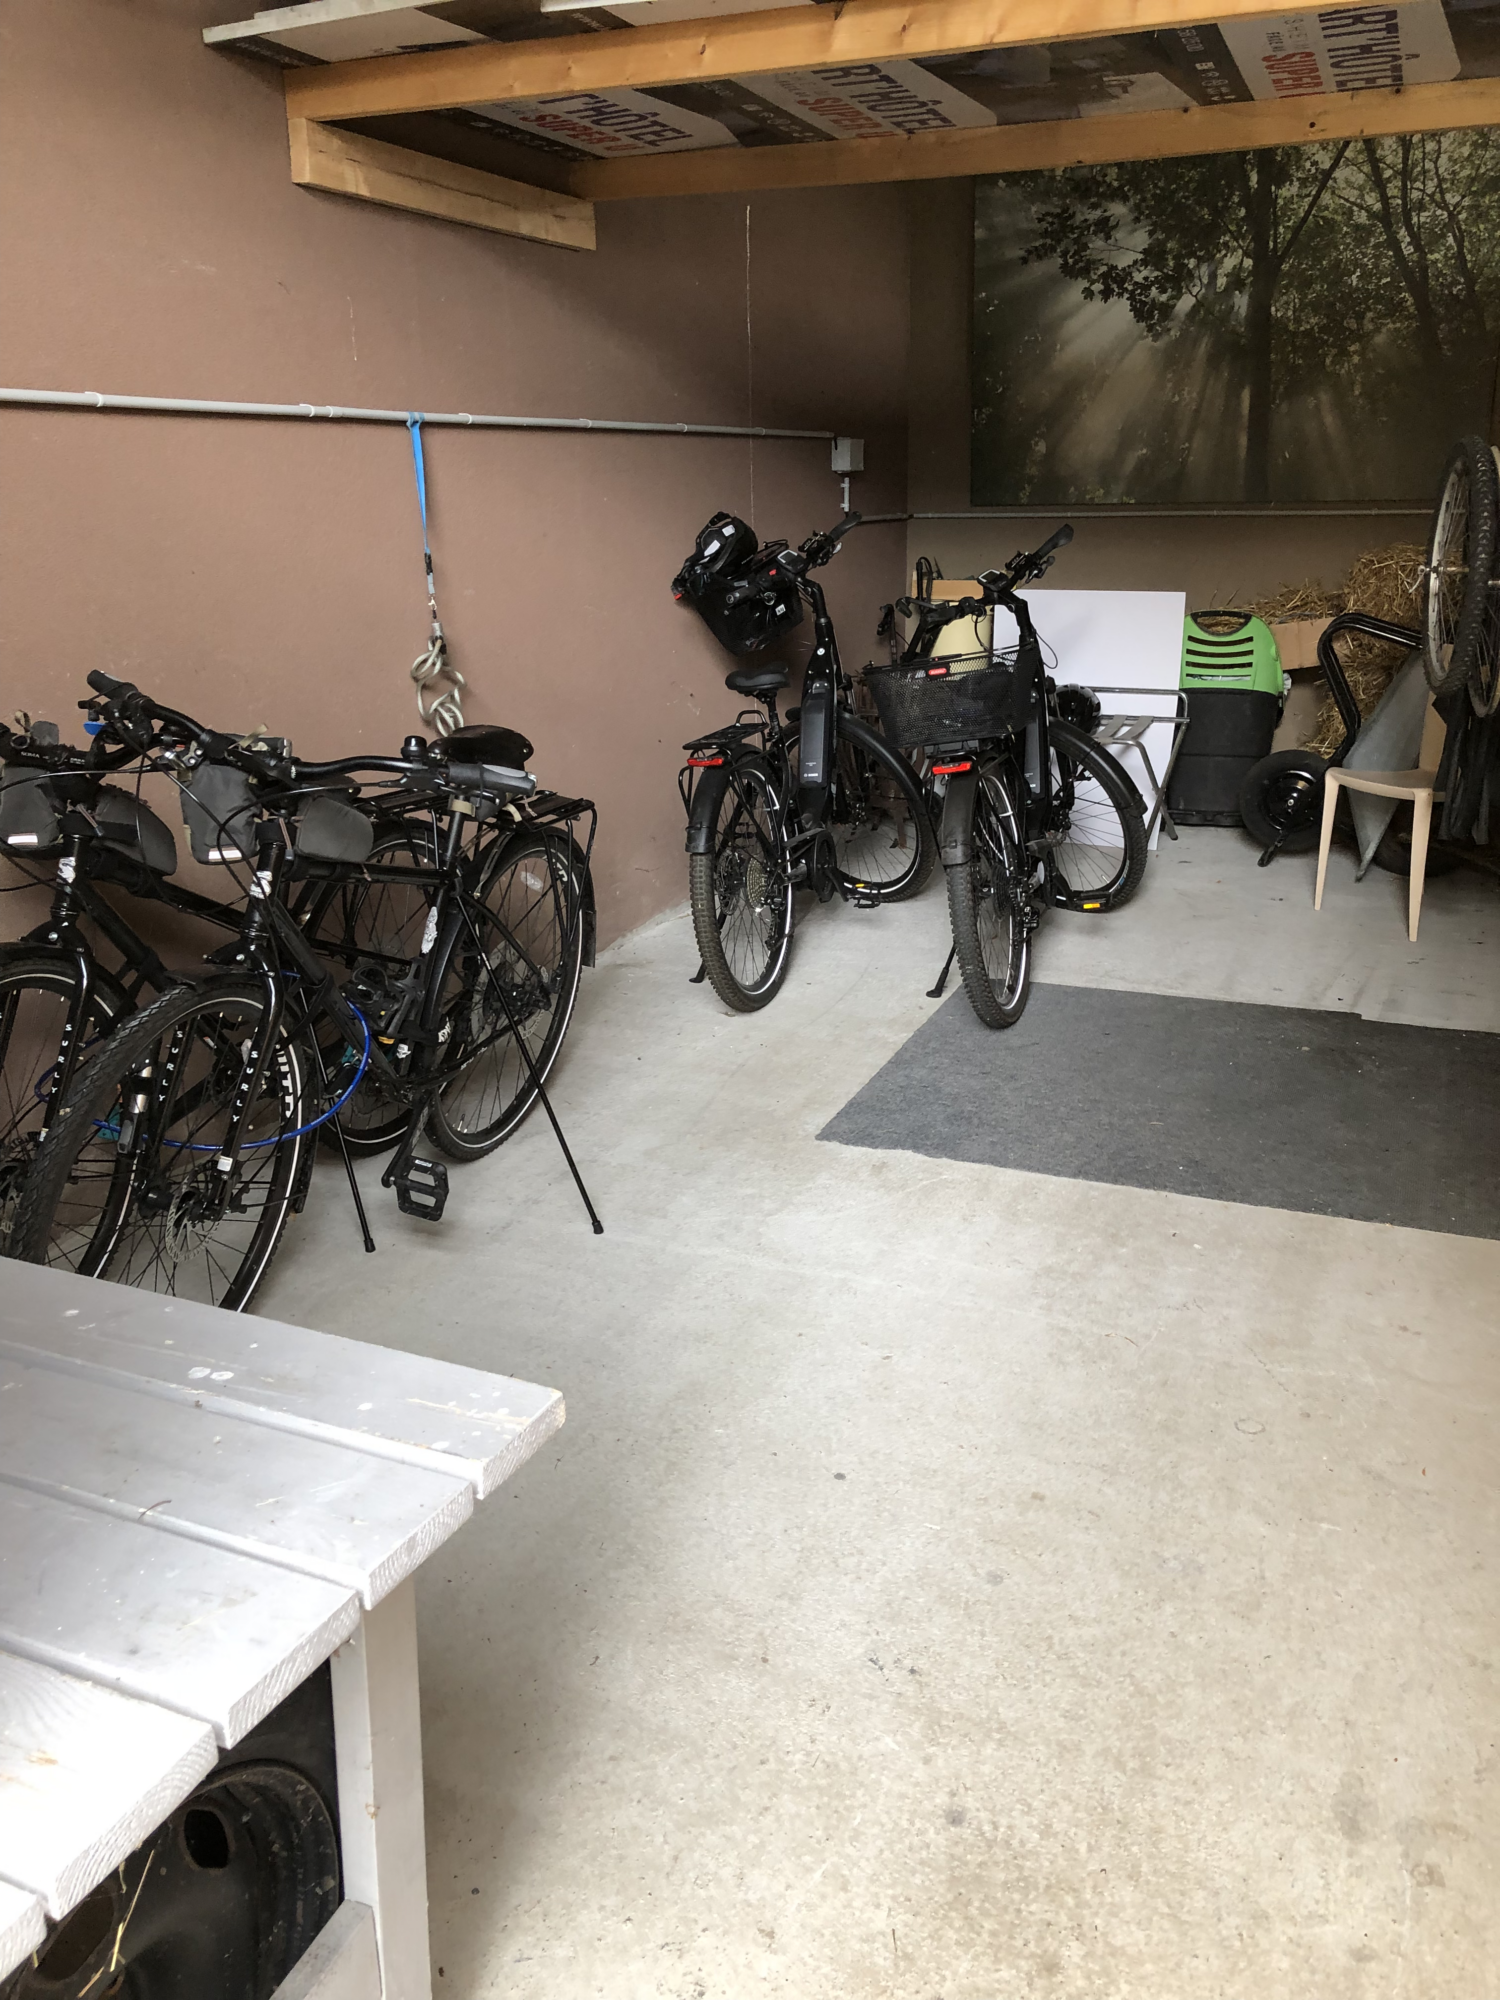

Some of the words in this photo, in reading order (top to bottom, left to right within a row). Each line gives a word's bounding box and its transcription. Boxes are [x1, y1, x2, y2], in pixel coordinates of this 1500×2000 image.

[1262, 51, 1323, 91] SUPER
[519, 113, 622, 145] SUPER
[797, 97, 883, 130] SUPER
[51, 1024, 72, 1094] SURLY
[159, 1031, 183, 1101] SURLY
[232, 1051, 258, 1122] SURLY
